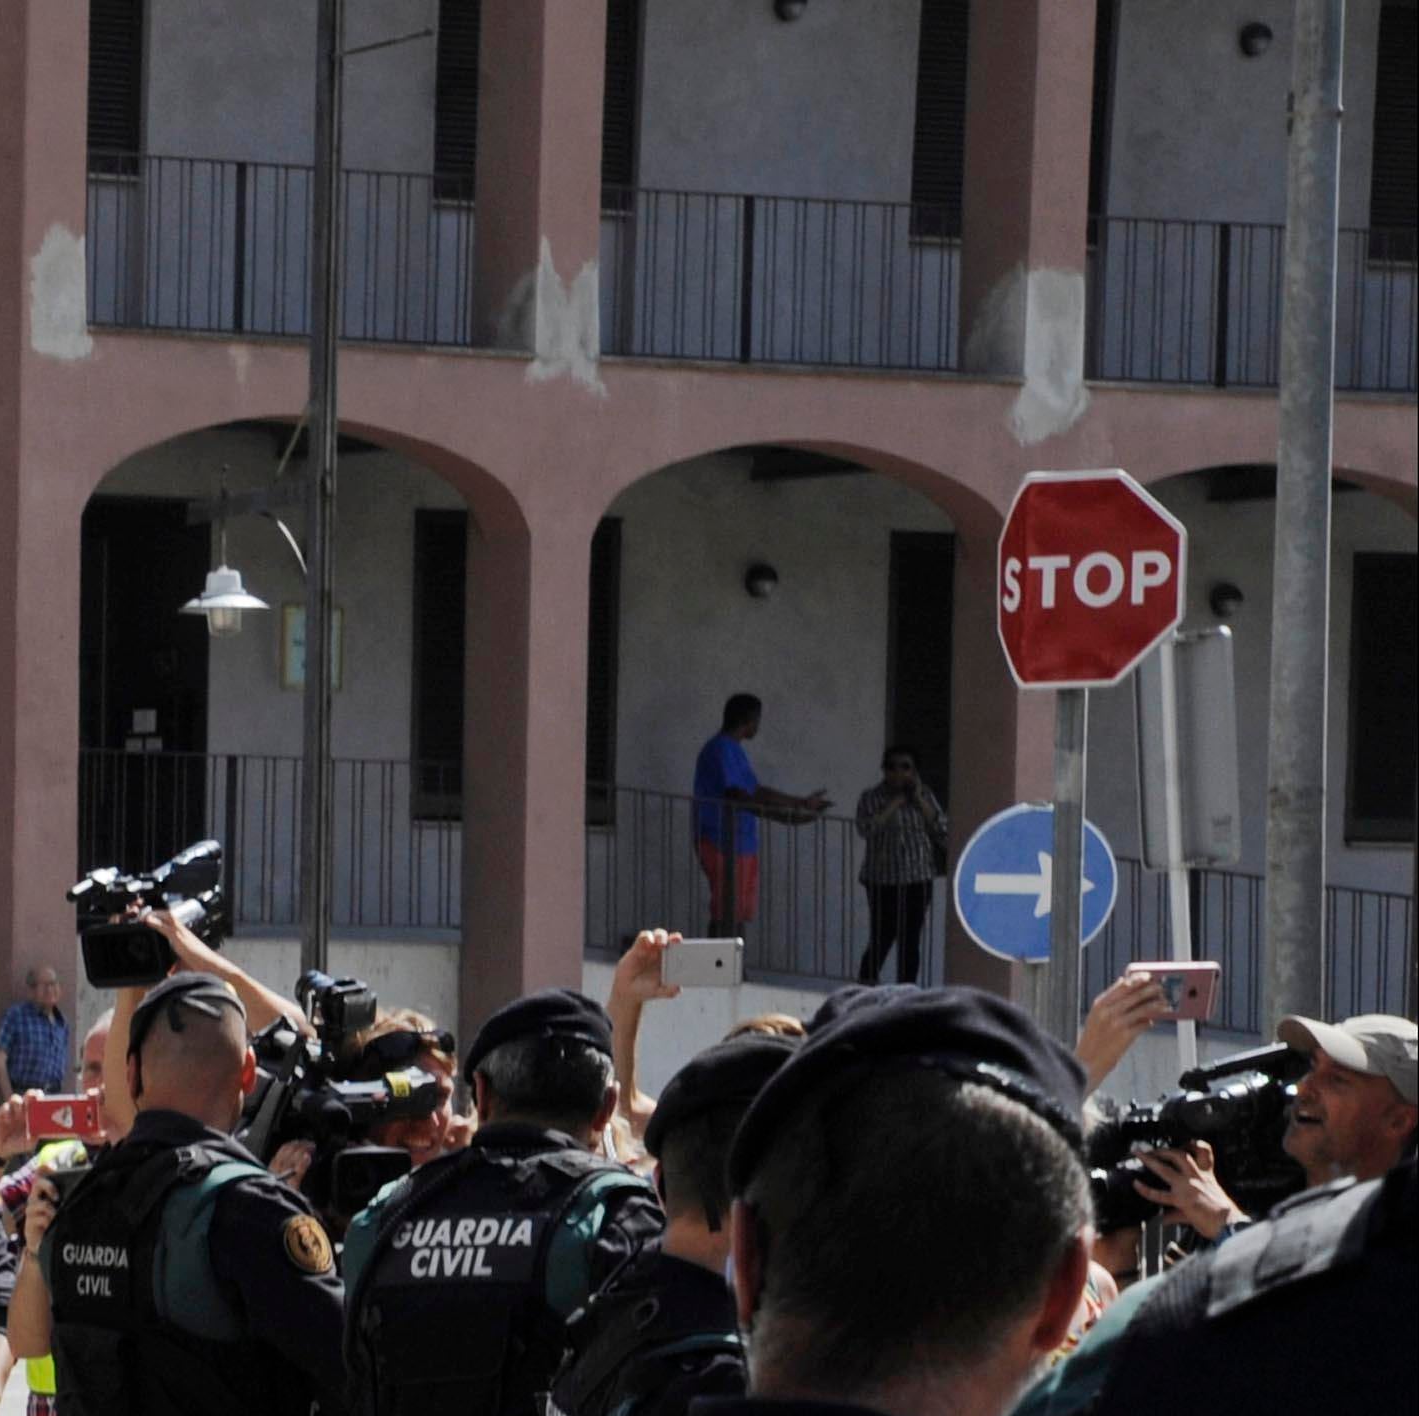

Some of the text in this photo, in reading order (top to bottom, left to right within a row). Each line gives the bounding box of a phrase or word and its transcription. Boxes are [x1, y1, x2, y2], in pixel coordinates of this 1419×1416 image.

[1002, 551, 1172, 614] STOP
[391, 1217, 533, 1250] GUARDIA
[62, 1242, 129, 1269] GUARDIA
[410, 1246, 493, 1278] CIVIL
[76, 1274, 113, 1297] CIVIL
